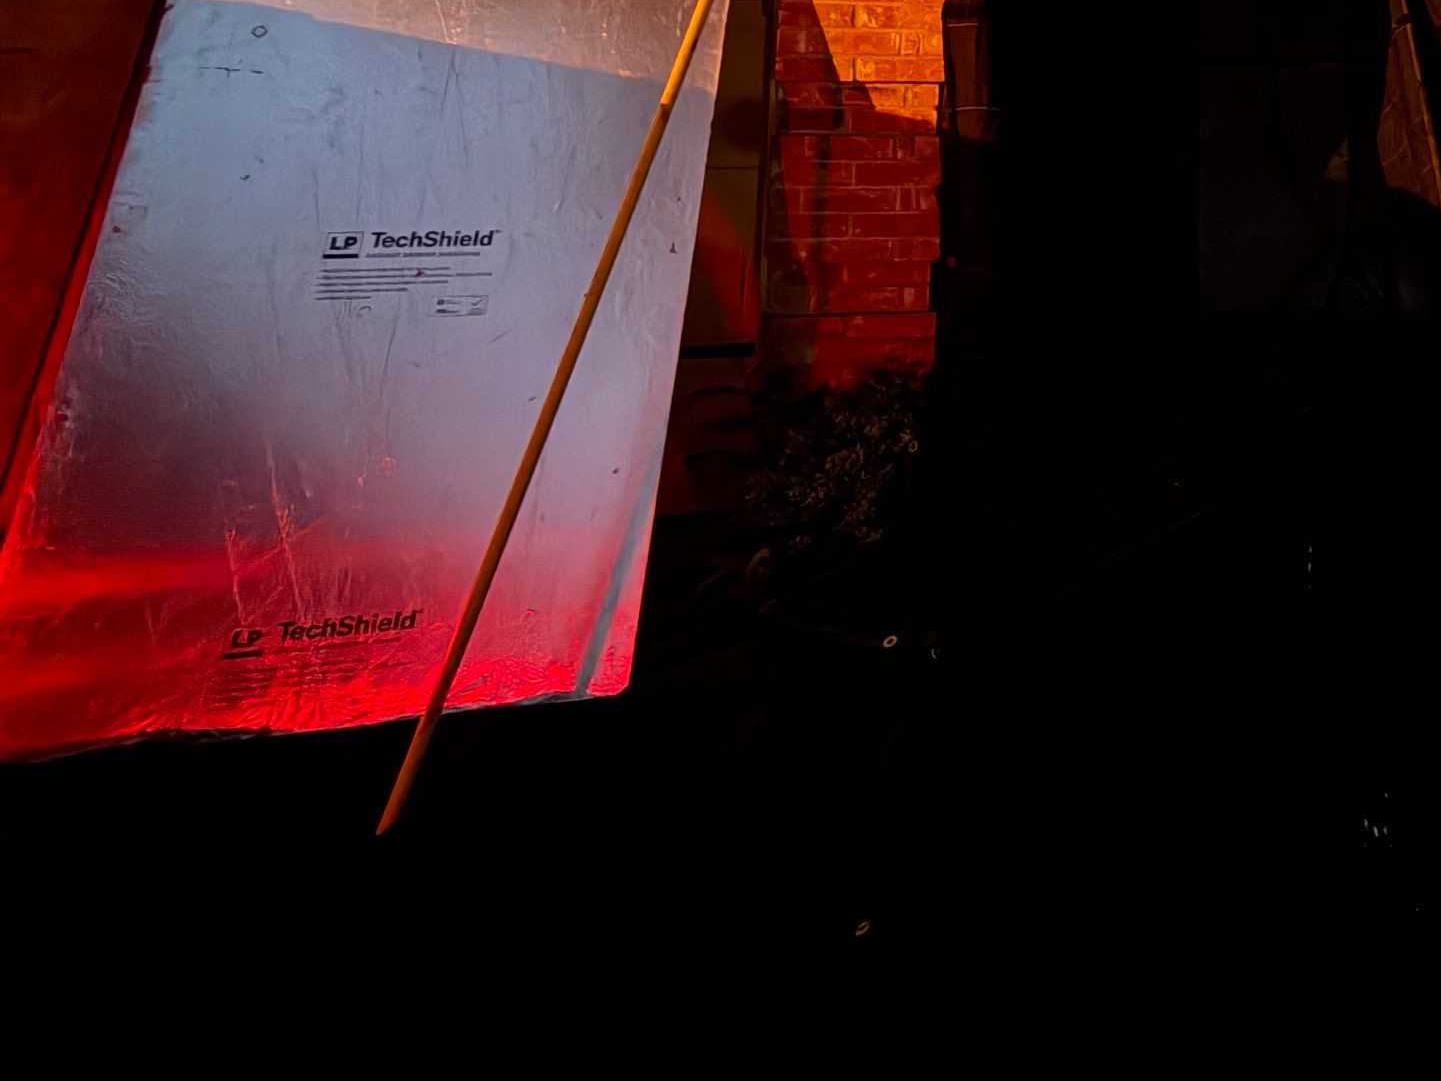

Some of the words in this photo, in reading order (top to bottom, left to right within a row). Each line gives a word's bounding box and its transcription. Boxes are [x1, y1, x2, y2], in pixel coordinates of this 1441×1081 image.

[329, 236, 358, 251] LP
[371, 230, 494, 249] TechShield
[277, 609, 418, 642] TechShield
